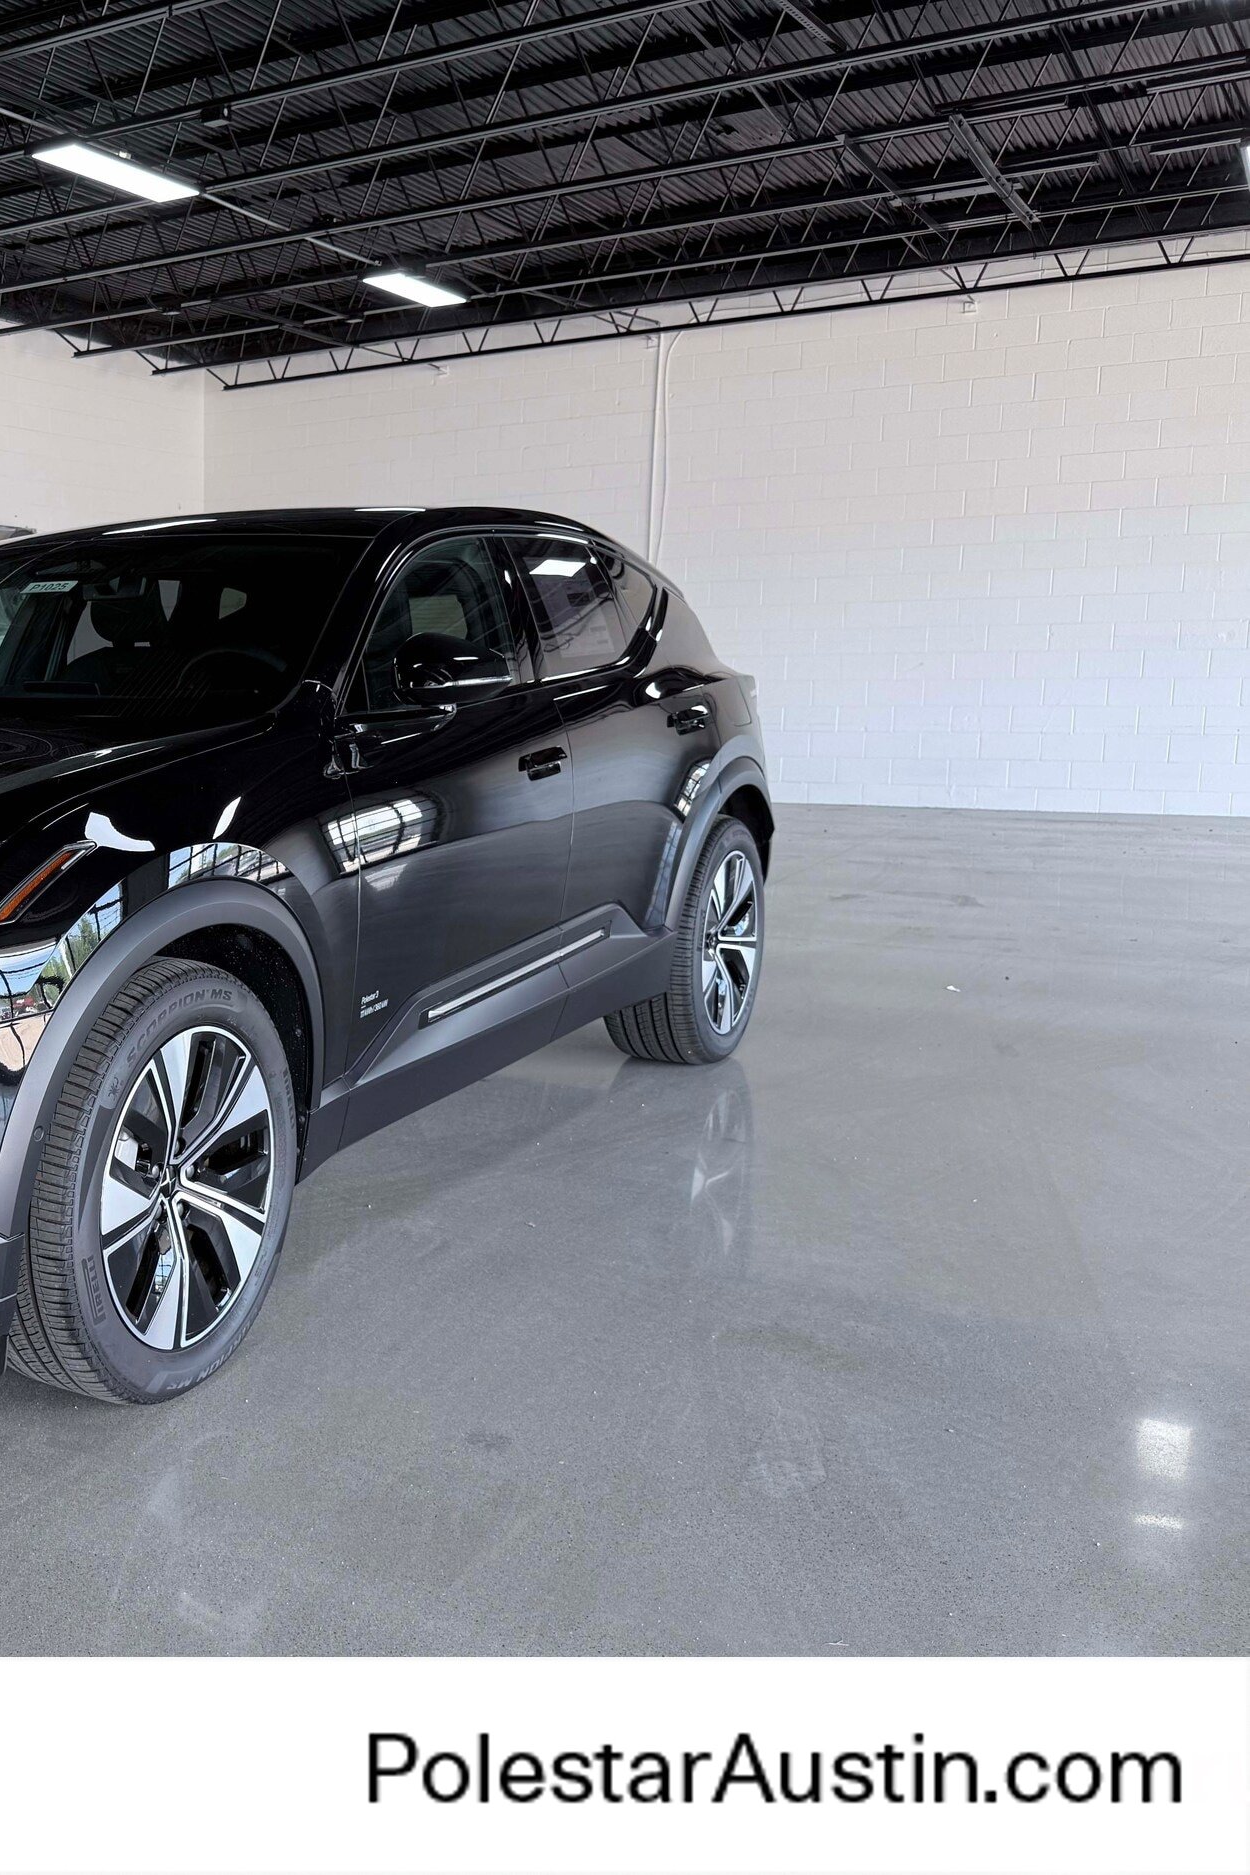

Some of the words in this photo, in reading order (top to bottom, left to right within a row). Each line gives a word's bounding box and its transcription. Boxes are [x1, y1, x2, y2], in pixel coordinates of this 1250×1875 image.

[30, 582, 69, 591] P1025
[126, 990, 206, 1066] SCORPION
[209, 989, 233, 1002] MS
[81, 1256, 107, 1326] PIRELLI
